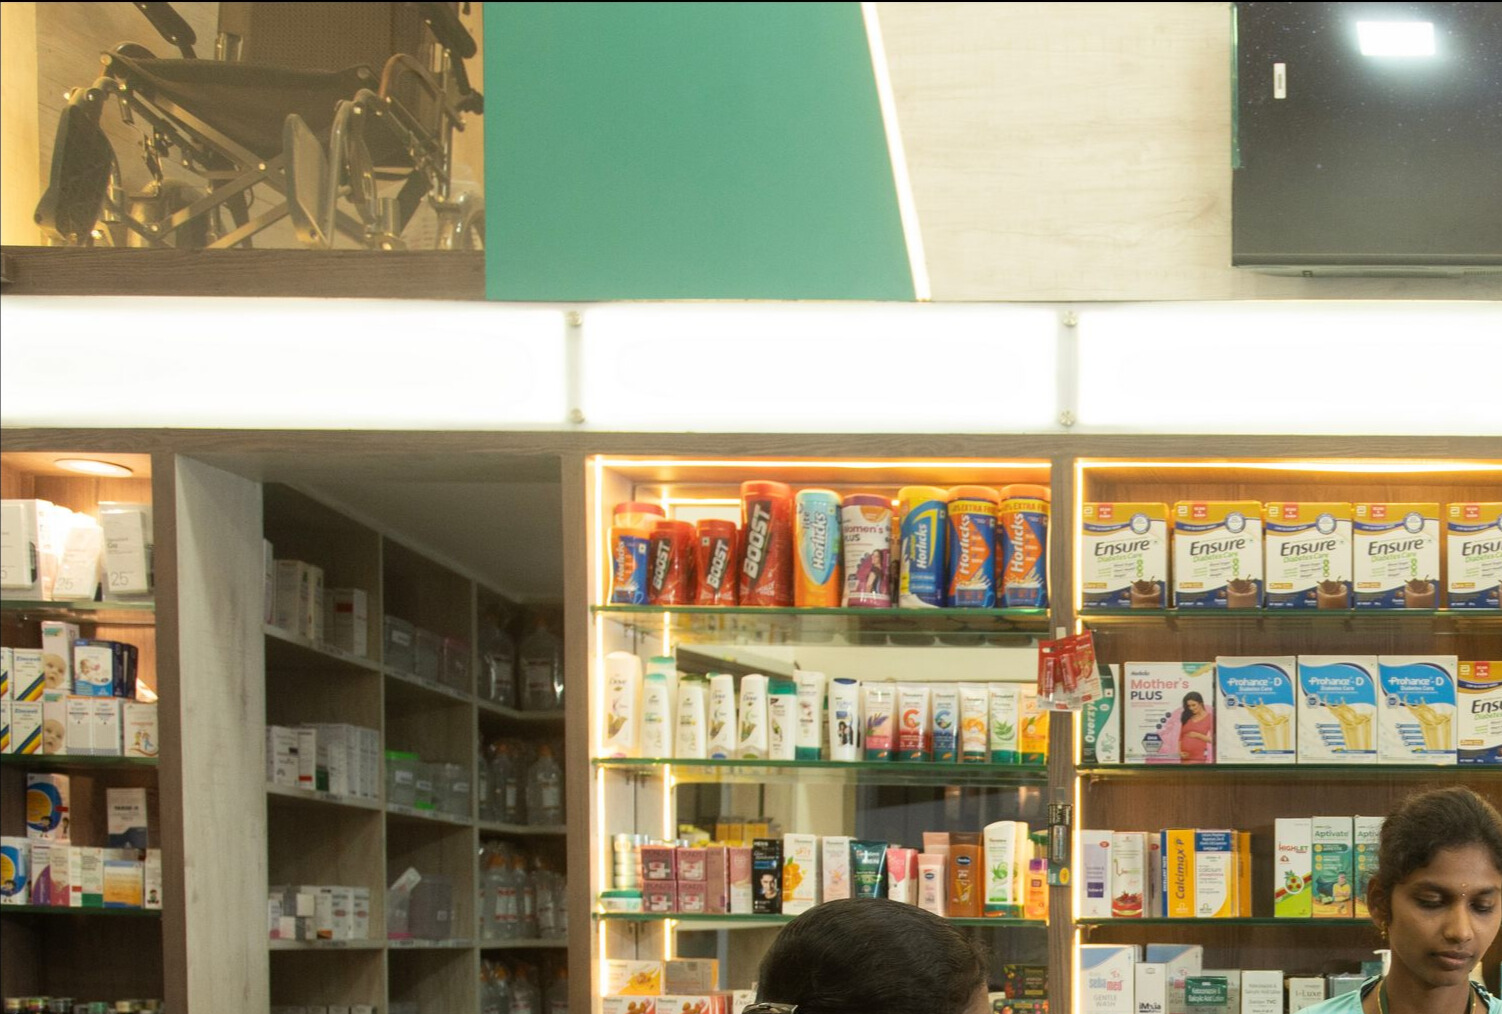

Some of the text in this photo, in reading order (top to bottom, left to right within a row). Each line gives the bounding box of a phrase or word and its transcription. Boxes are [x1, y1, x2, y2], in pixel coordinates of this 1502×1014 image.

[743, 503, 772, 580] BOOST
[812, 511, 827, 571] Horlicks
[916, 523, 928, 569] Horlicks
[960, 514, 970, 575] Horlicks
[1010, 513, 1025, 573] Horlicks
[1094, 538, 1151, 557] Ensure
[1189, 537, 1246, 557] Ensure
[1280, 538, 1336, 557] Ensure
[1367, 537, 1425, 557] Ensure
[110, 571, 129, 586] 25
[653, 540, 671, 591] BOOST
[707, 539, 729, 589] BOOST
[1130, 677, 1190, 689] Mother's
[1130, 690, 1163, 700] PLUS
